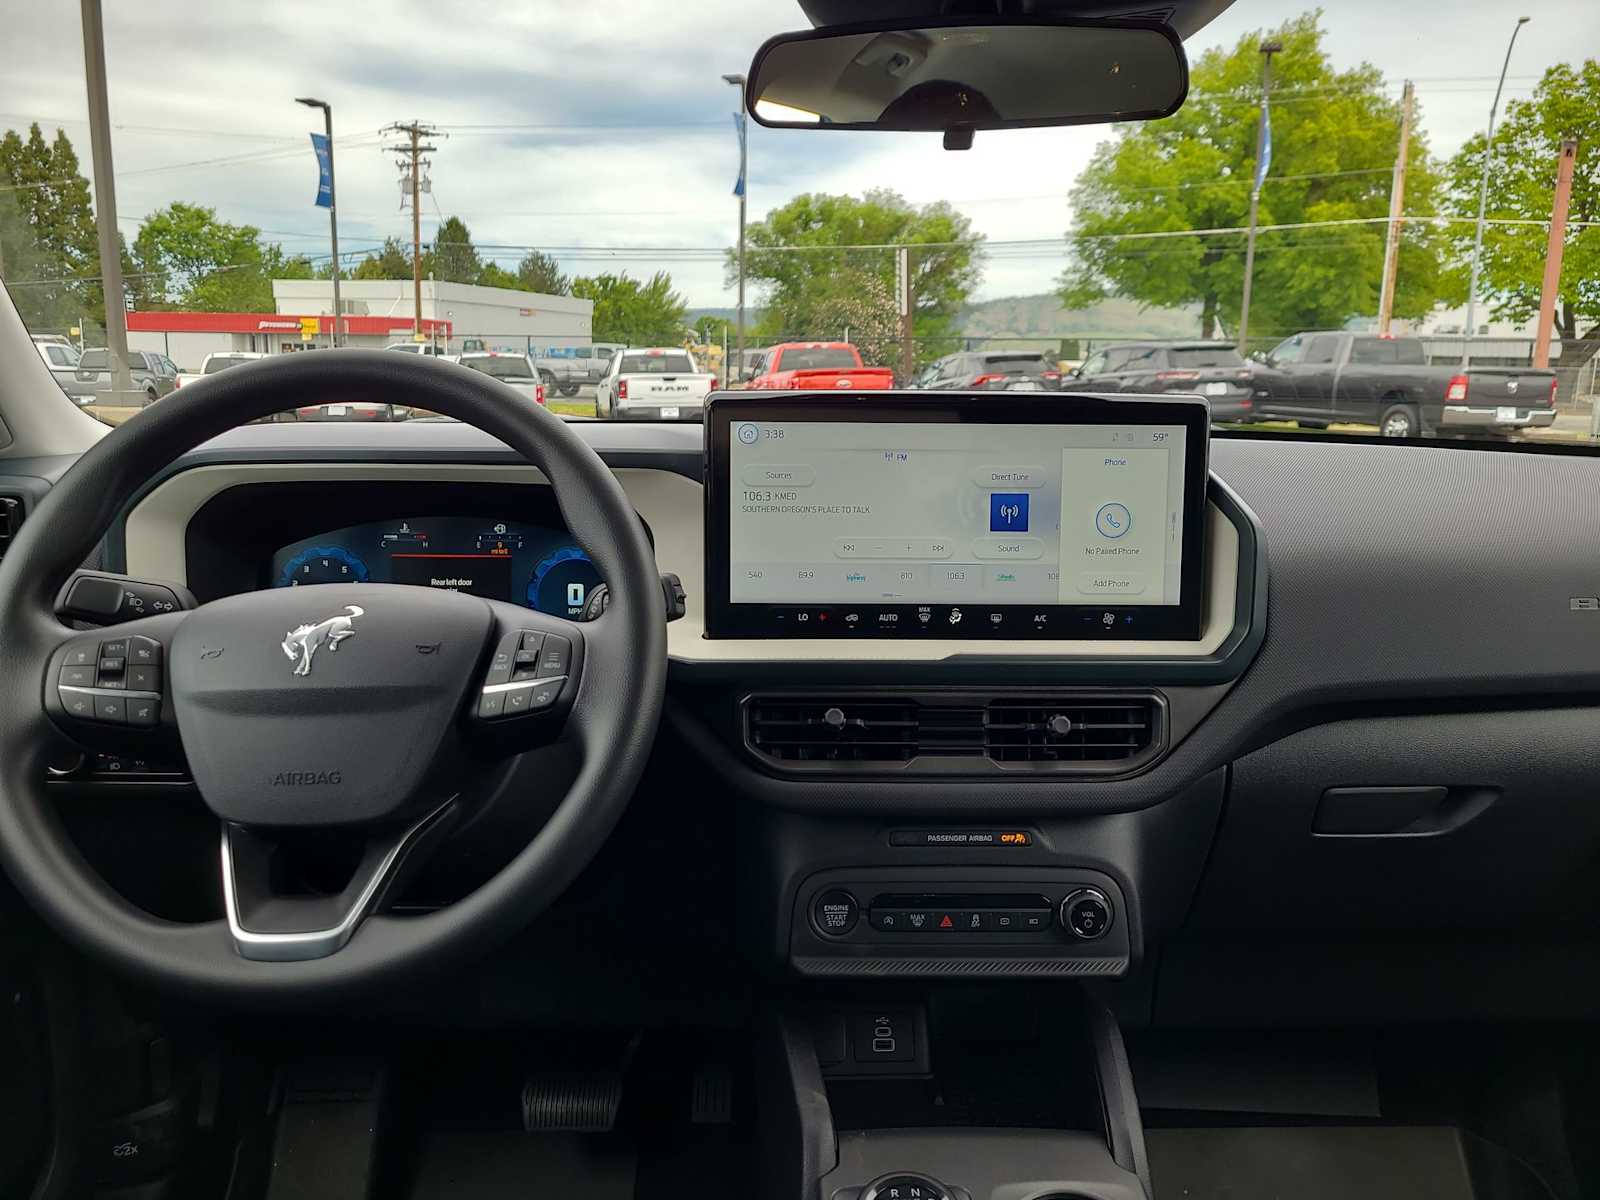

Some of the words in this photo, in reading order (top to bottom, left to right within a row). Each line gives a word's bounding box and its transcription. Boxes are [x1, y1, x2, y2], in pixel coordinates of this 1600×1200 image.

[765, 429, 785, 439] 3:38
[896, 453, 908, 462] FM
[1104, 458, 1127, 466] Phone
[765, 470, 793, 480] Sources
[991, 472, 1010, 481] Direct
[1012, 472, 1030, 481] Tune
[743, 491, 772, 502] 106.3
[774, 492, 798, 501] KMED
[742, 504, 781, 514] SOUTHERN
[781, 504, 817, 514] OREGON'S
[817, 504, 840, 514] PLACE
[841, 504, 852, 514] TO
[853, 504, 870, 514] TALK
[422, 541, 429, 549] H
[998, 544, 1020, 552] Sound
[1085, 547, 1095, 556] No
[1097, 547, 1118, 556] Paired
[1118, 547, 1140, 556] Phone
[341, 566, 348, 574] 5
[748, 570, 763, 579] 540
[798, 570, 814, 579] 89.9
[900, 571, 913, 580] 810
[947, 571, 965, 580] 106.3
[431, 578, 446, 587] Rear
[446, 578, 457, 586] left
[458, 578, 472, 586] door
[1093, 579, 1107, 588] Add
[1108, 579, 1130, 588] Phone
[567, 583, 585, 606] 0
[798, 613, 809, 622] LO
[878, 613, 898, 622] AUTO
[1034, 614, 1047, 623] A/C
[273, 771, 342, 786] AIRBAG
[1001, 834, 1015, 843] OFF
[1081, 911, 1096, 919] VOL
[891, 1189, 899, 1198] R
[911, 1188, 920, 1197] N
